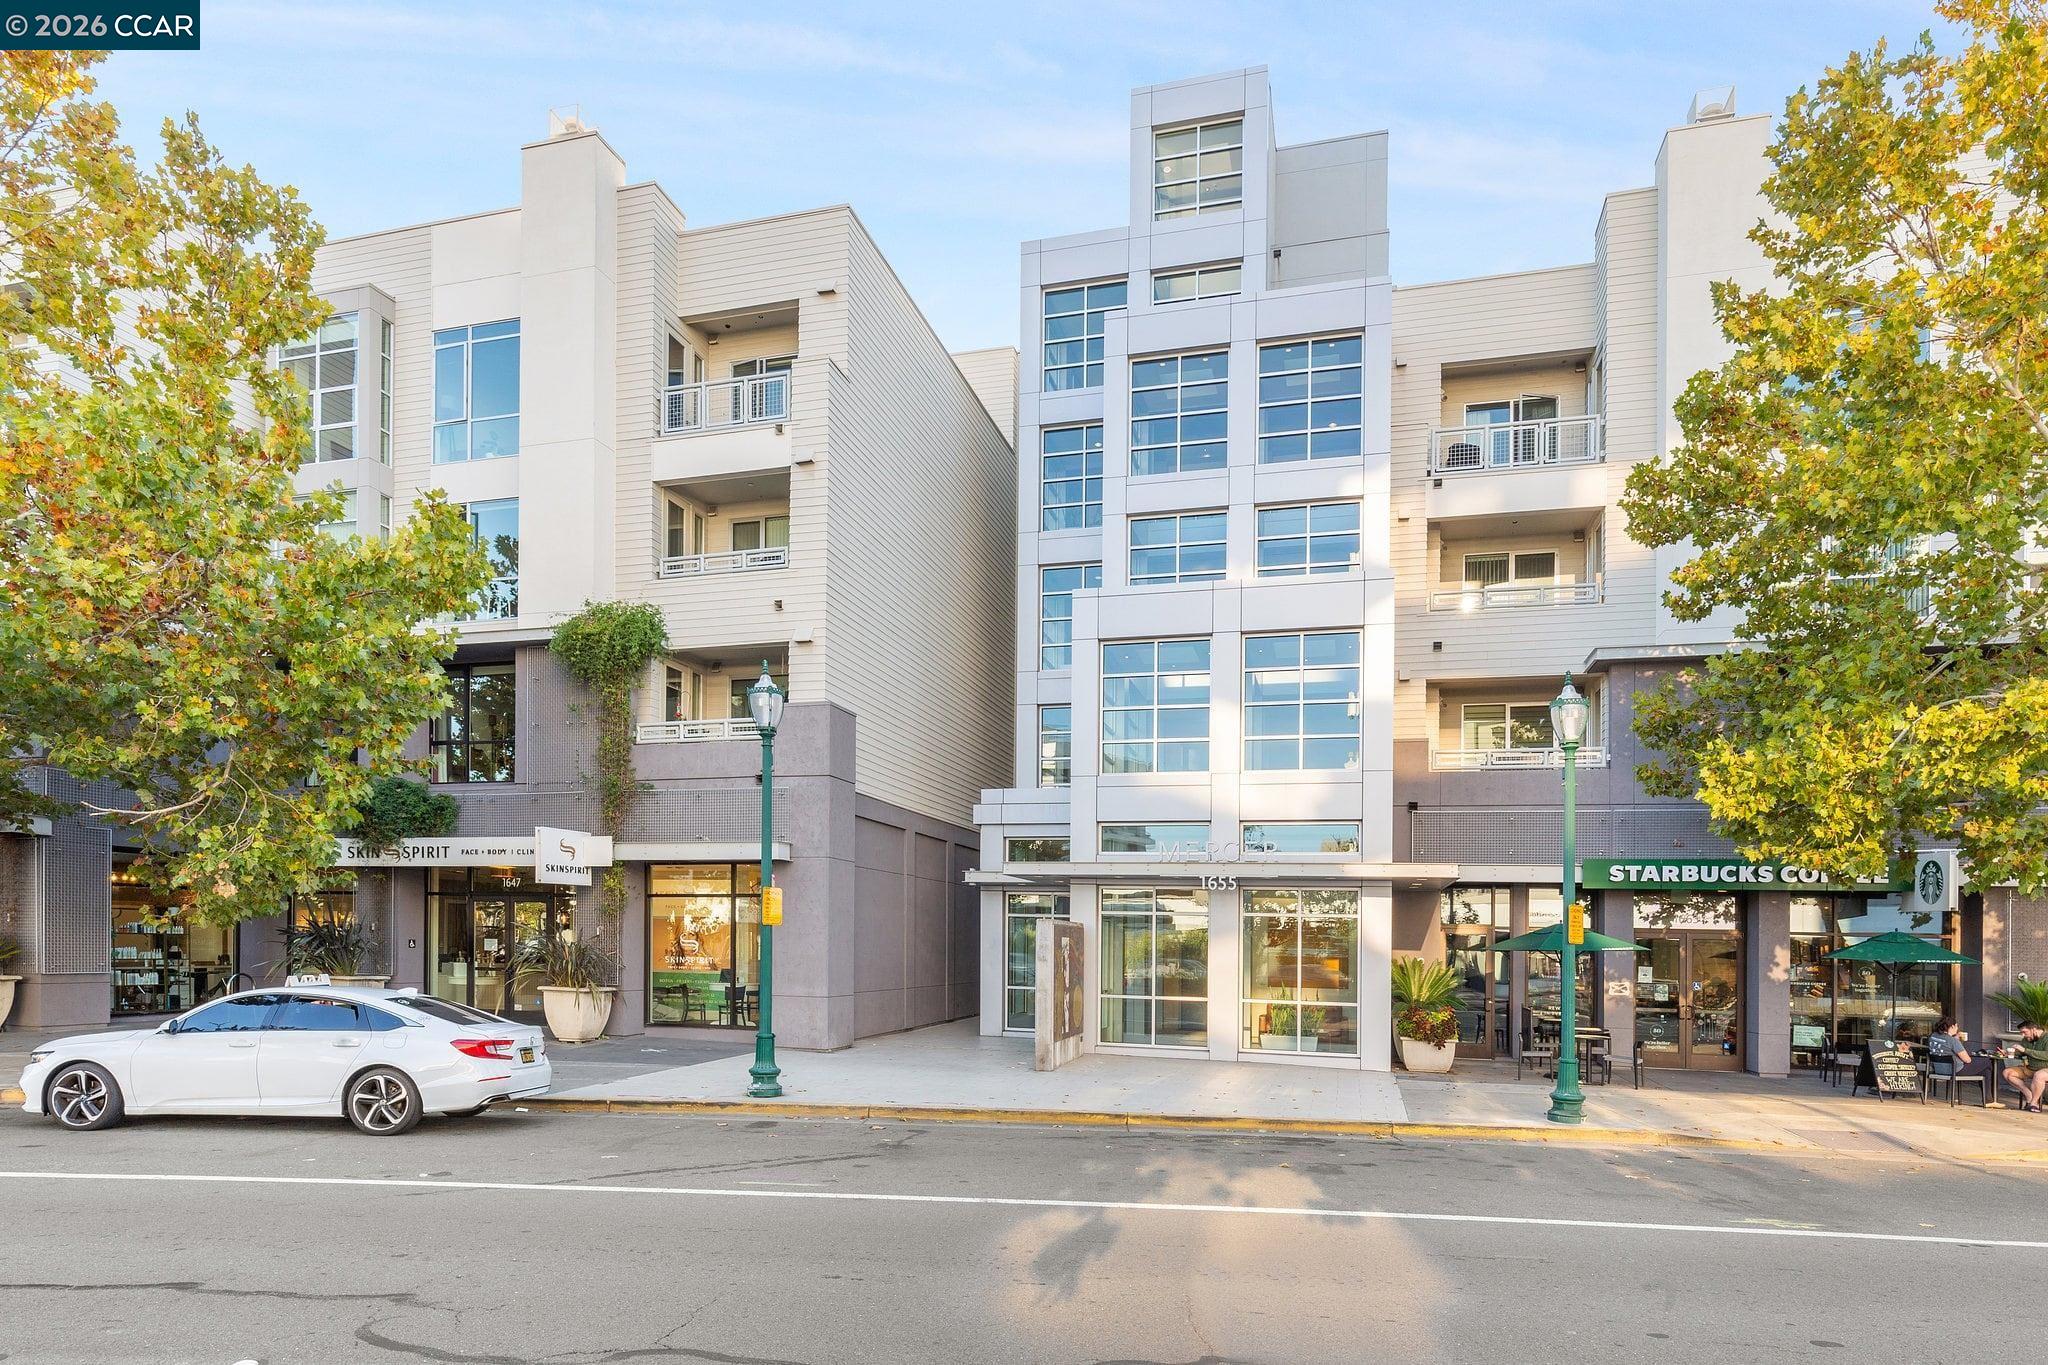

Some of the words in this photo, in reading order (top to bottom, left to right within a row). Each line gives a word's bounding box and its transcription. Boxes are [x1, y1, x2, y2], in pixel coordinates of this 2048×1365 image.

[402, 846, 450, 859] SPIRIT
[1160, 840, 1279, 863] MERCER
[545, 863, 590, 875] SKINSPIRIT
[1608, 865, 1775, 883] STARBUCKS
[502, 877, 521, 888] 1647
[1199, 876, 1237, 891] 1655
